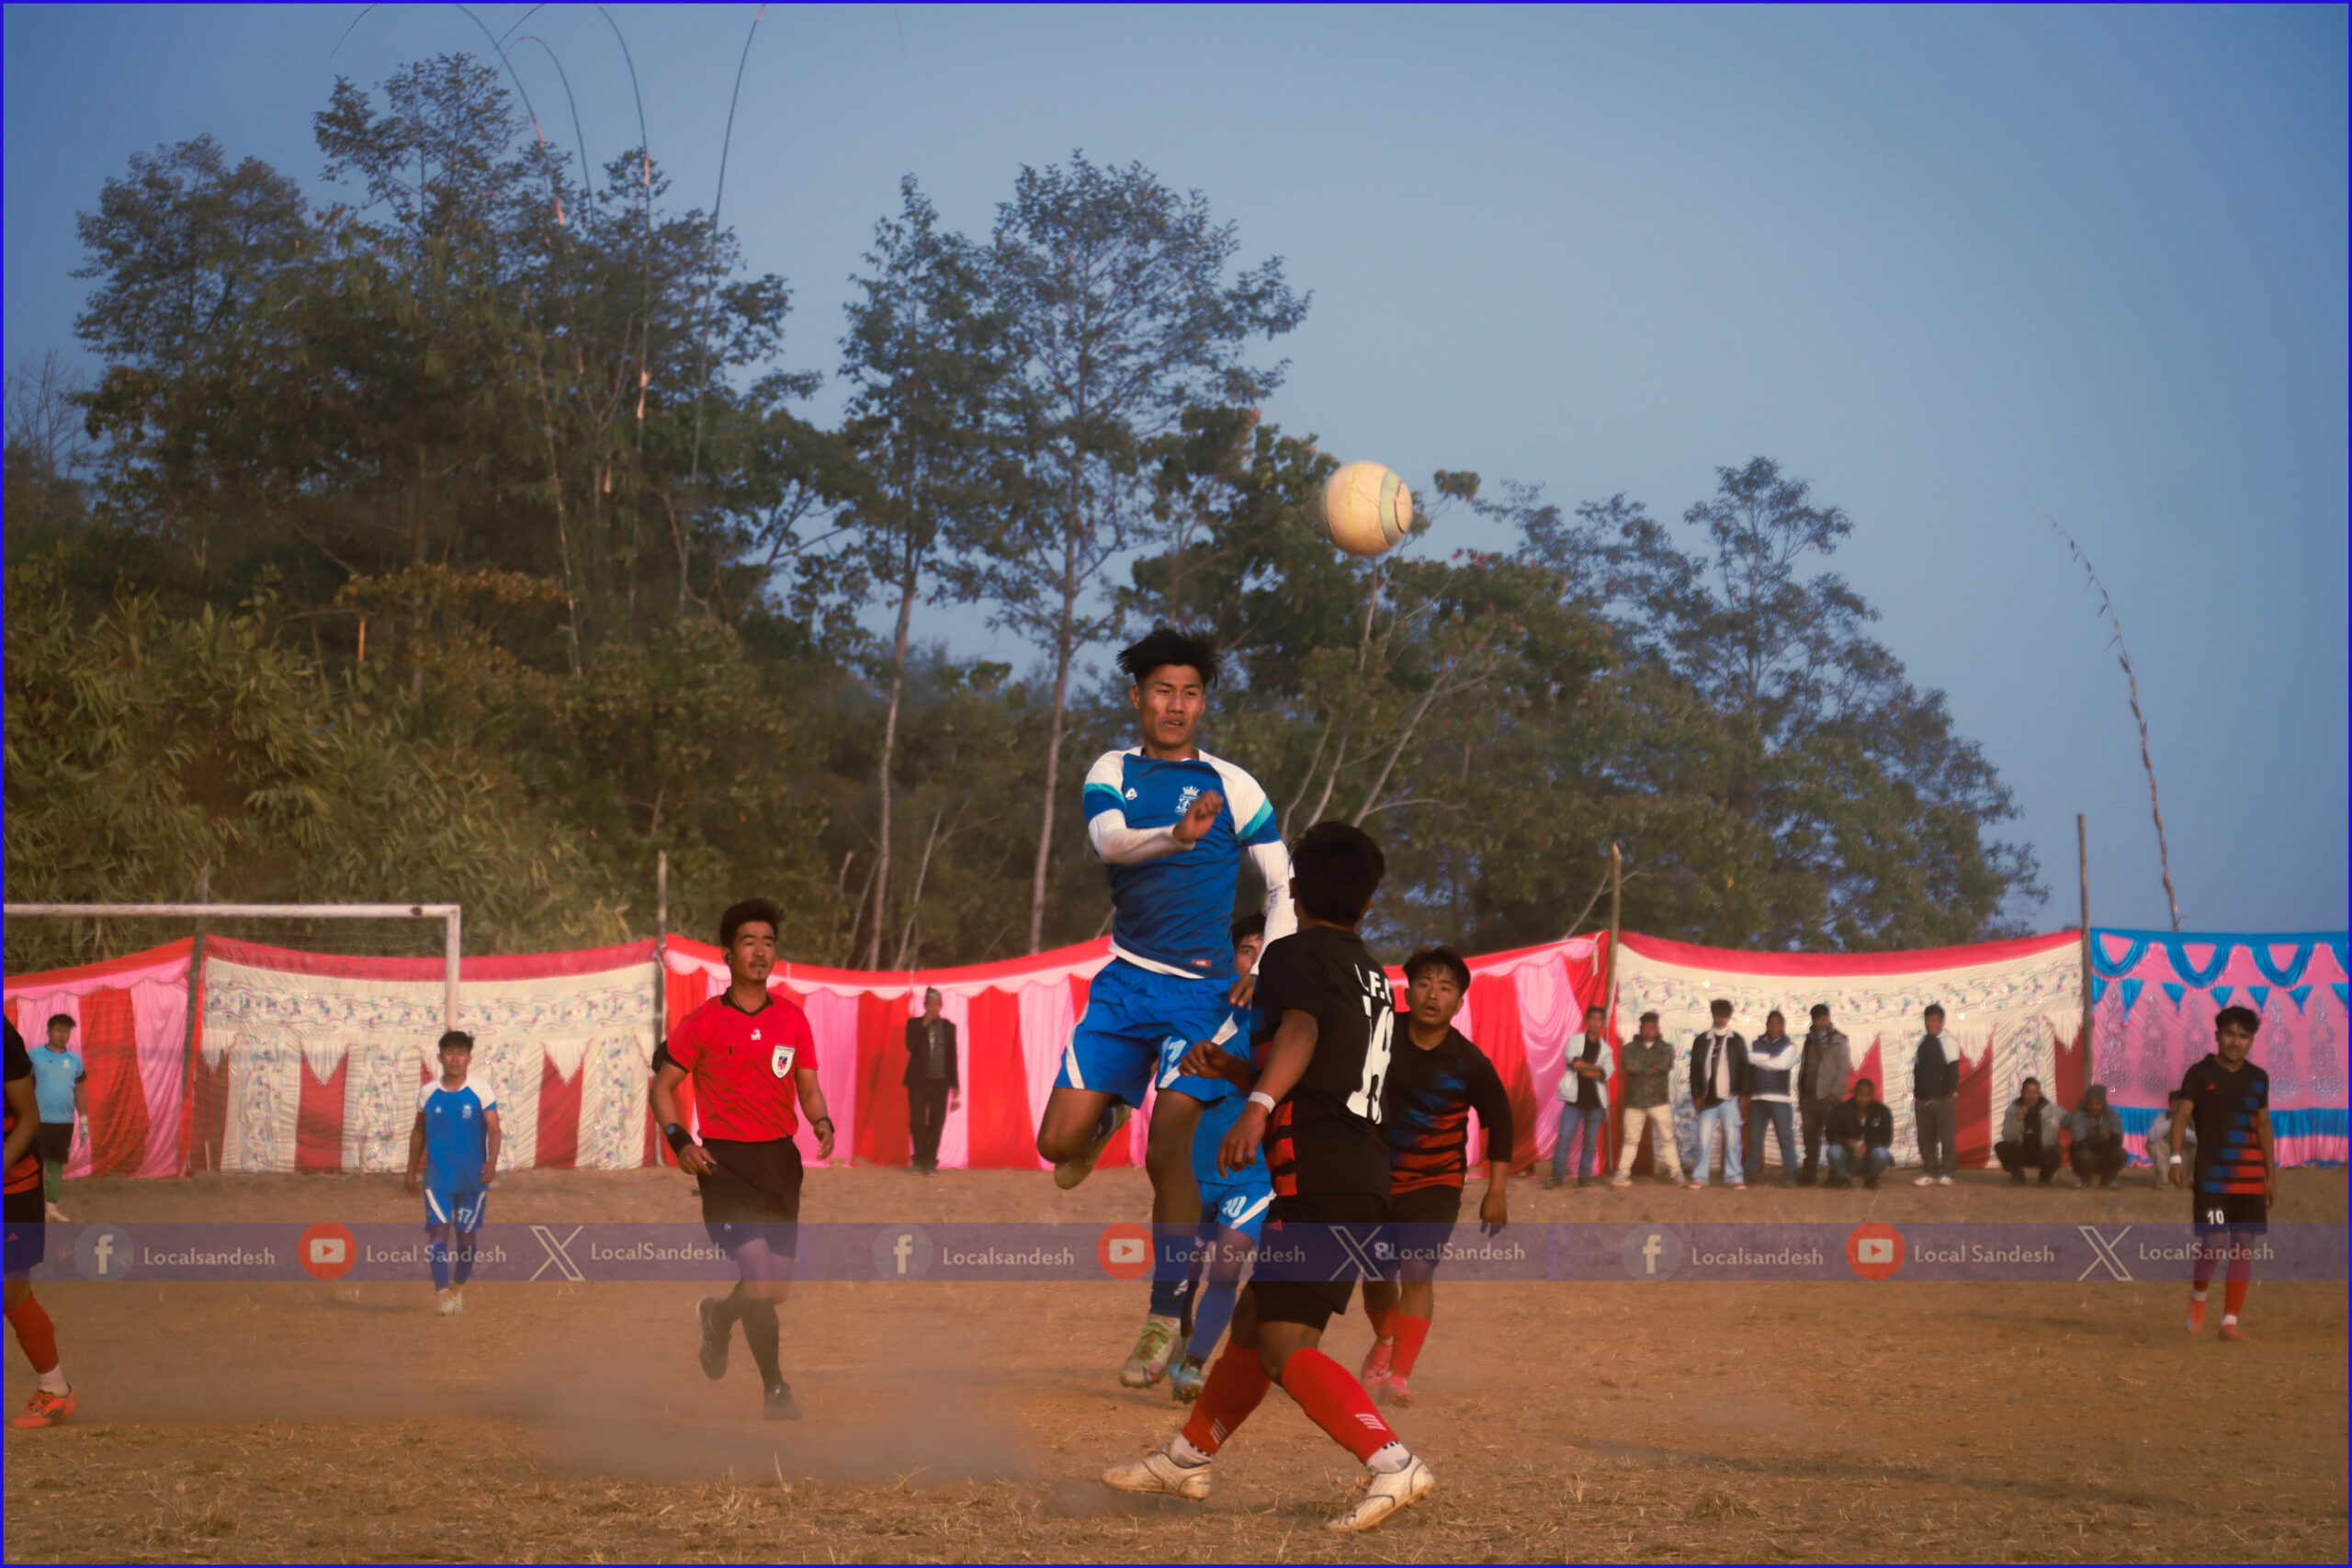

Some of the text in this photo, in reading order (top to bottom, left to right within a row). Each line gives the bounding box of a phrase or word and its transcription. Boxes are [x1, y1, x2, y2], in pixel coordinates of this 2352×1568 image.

[458, 1207, 473, 1224] 17
[1222, 1195, 1247, 1219] 10
[2207, 1209, 2225, 1225] 10
